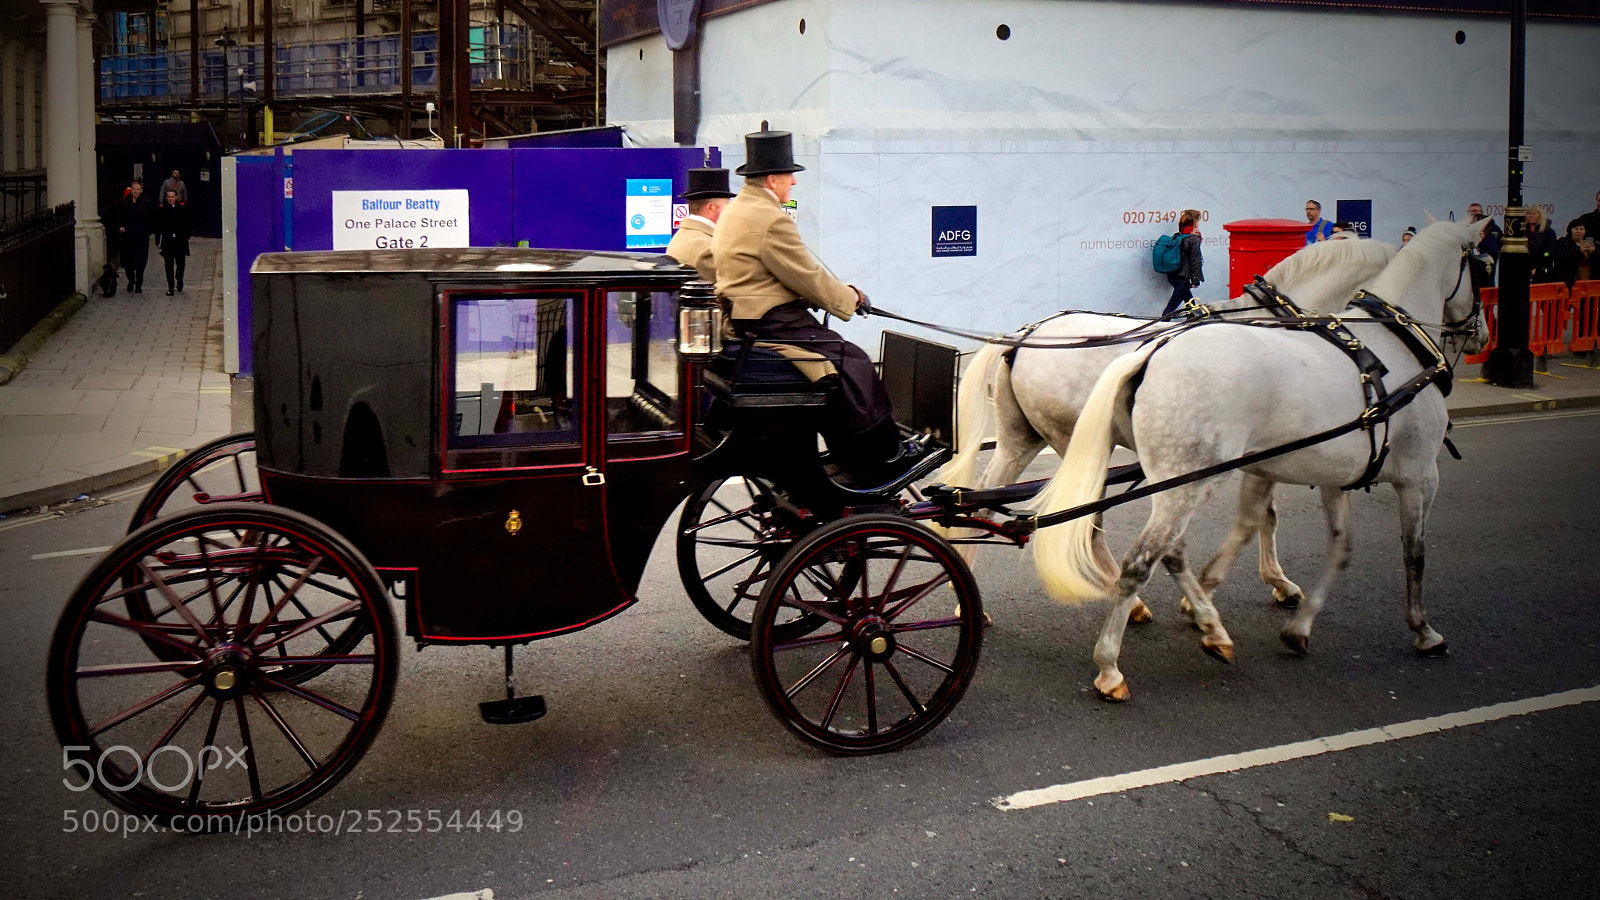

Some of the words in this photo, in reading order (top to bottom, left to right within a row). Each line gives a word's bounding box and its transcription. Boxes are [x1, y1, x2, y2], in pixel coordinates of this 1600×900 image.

[362, 199, 402, 211] Balfour
[405, 198, 440, 212] Beatty
[344, 218, 371, 229] One
[375, 218, 417, 229] Palace
[421, 217, 458, 228] Street
[1123, 211, 1145, 224] 020
[1148, 210, 1177, 224] 7349
[375, 235, 414, 249] Gate
[419, 235, 429, 248] 2
[938, 229, 971, 242] ADFG
